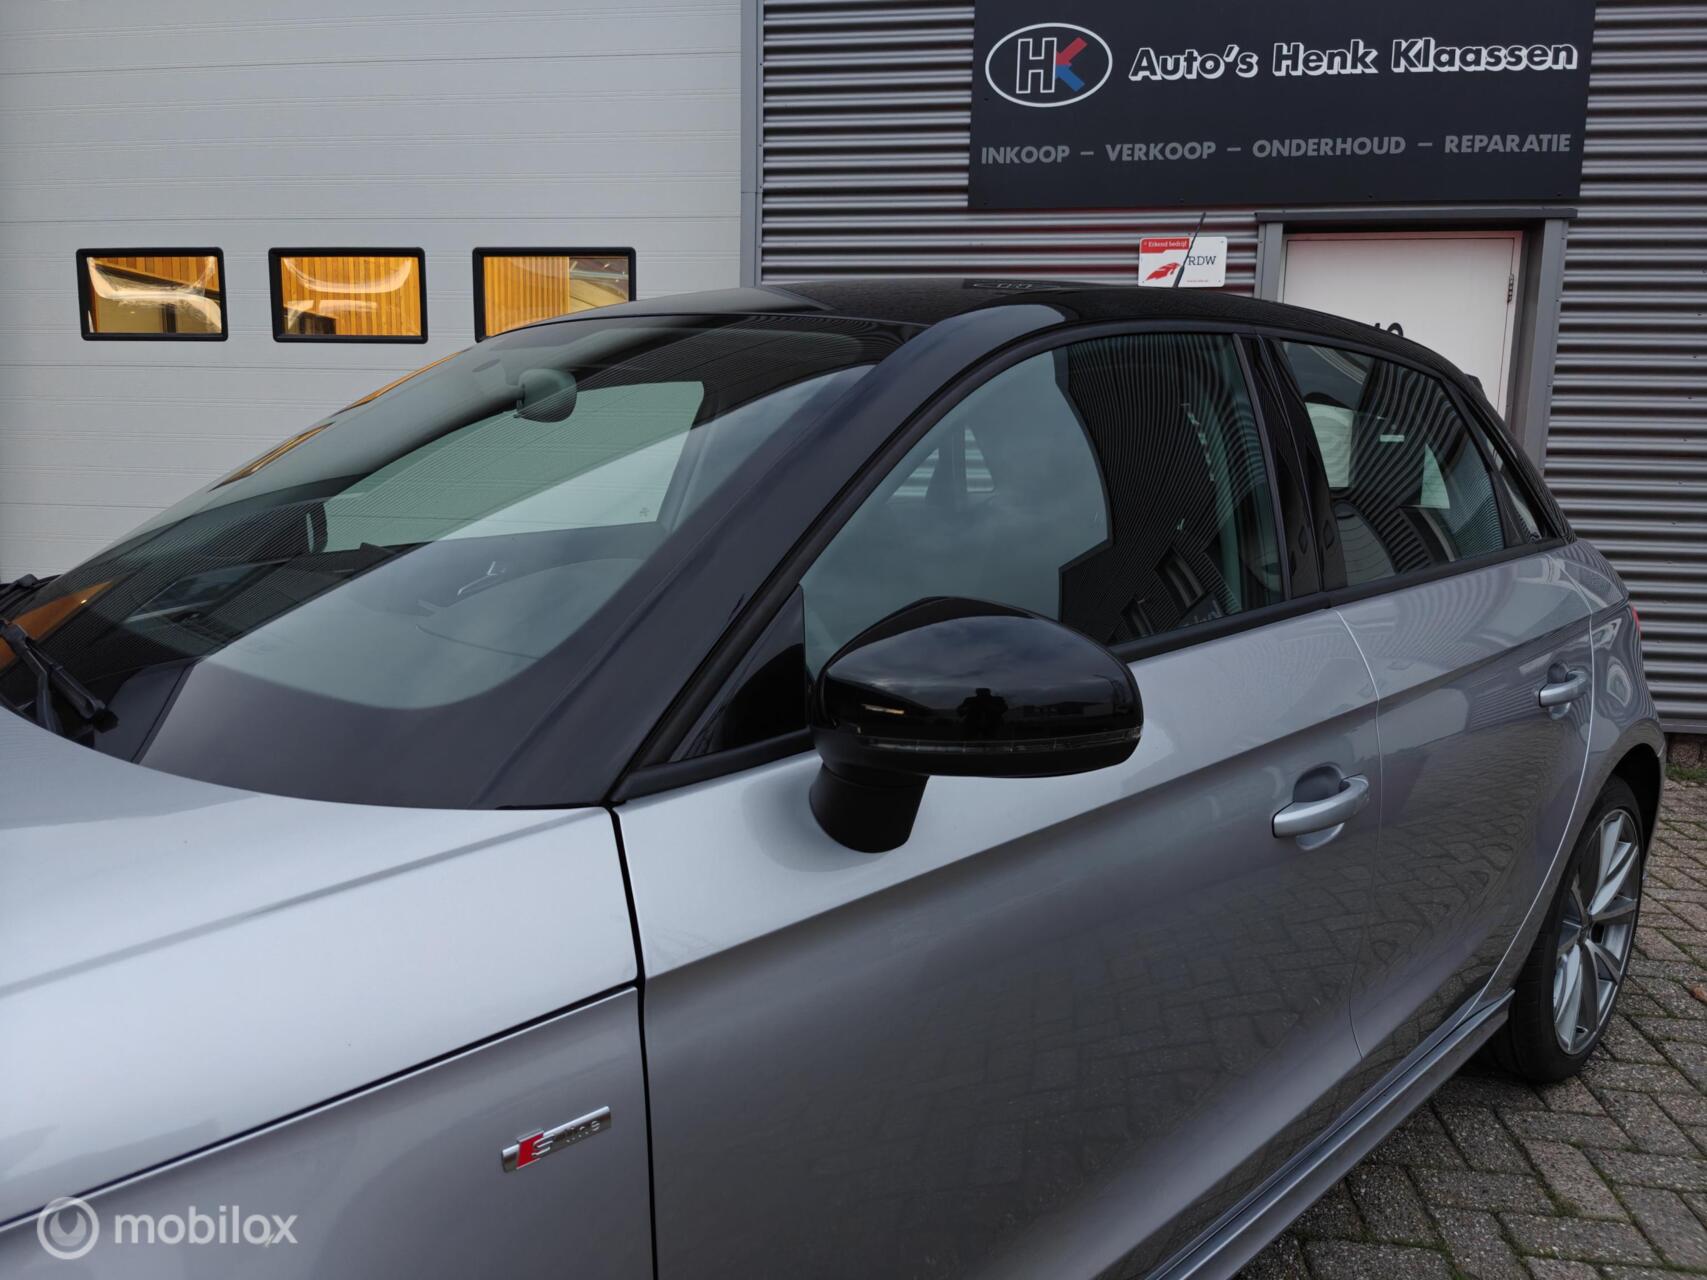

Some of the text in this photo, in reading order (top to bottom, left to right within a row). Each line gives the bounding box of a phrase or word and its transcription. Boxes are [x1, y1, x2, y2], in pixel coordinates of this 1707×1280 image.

[1128, 37, 1578, 81] Auto's Henk Klaassen
[981, 146, 1070, 164] INKOOP
[1105, 141, 1216, 162] VERKOOP
[1252, 136, 1406, 158] ONDERHOUD
[1444, 133, 1572, 153] REPARATIE
[1188, 256, 1217, 266] RDW
